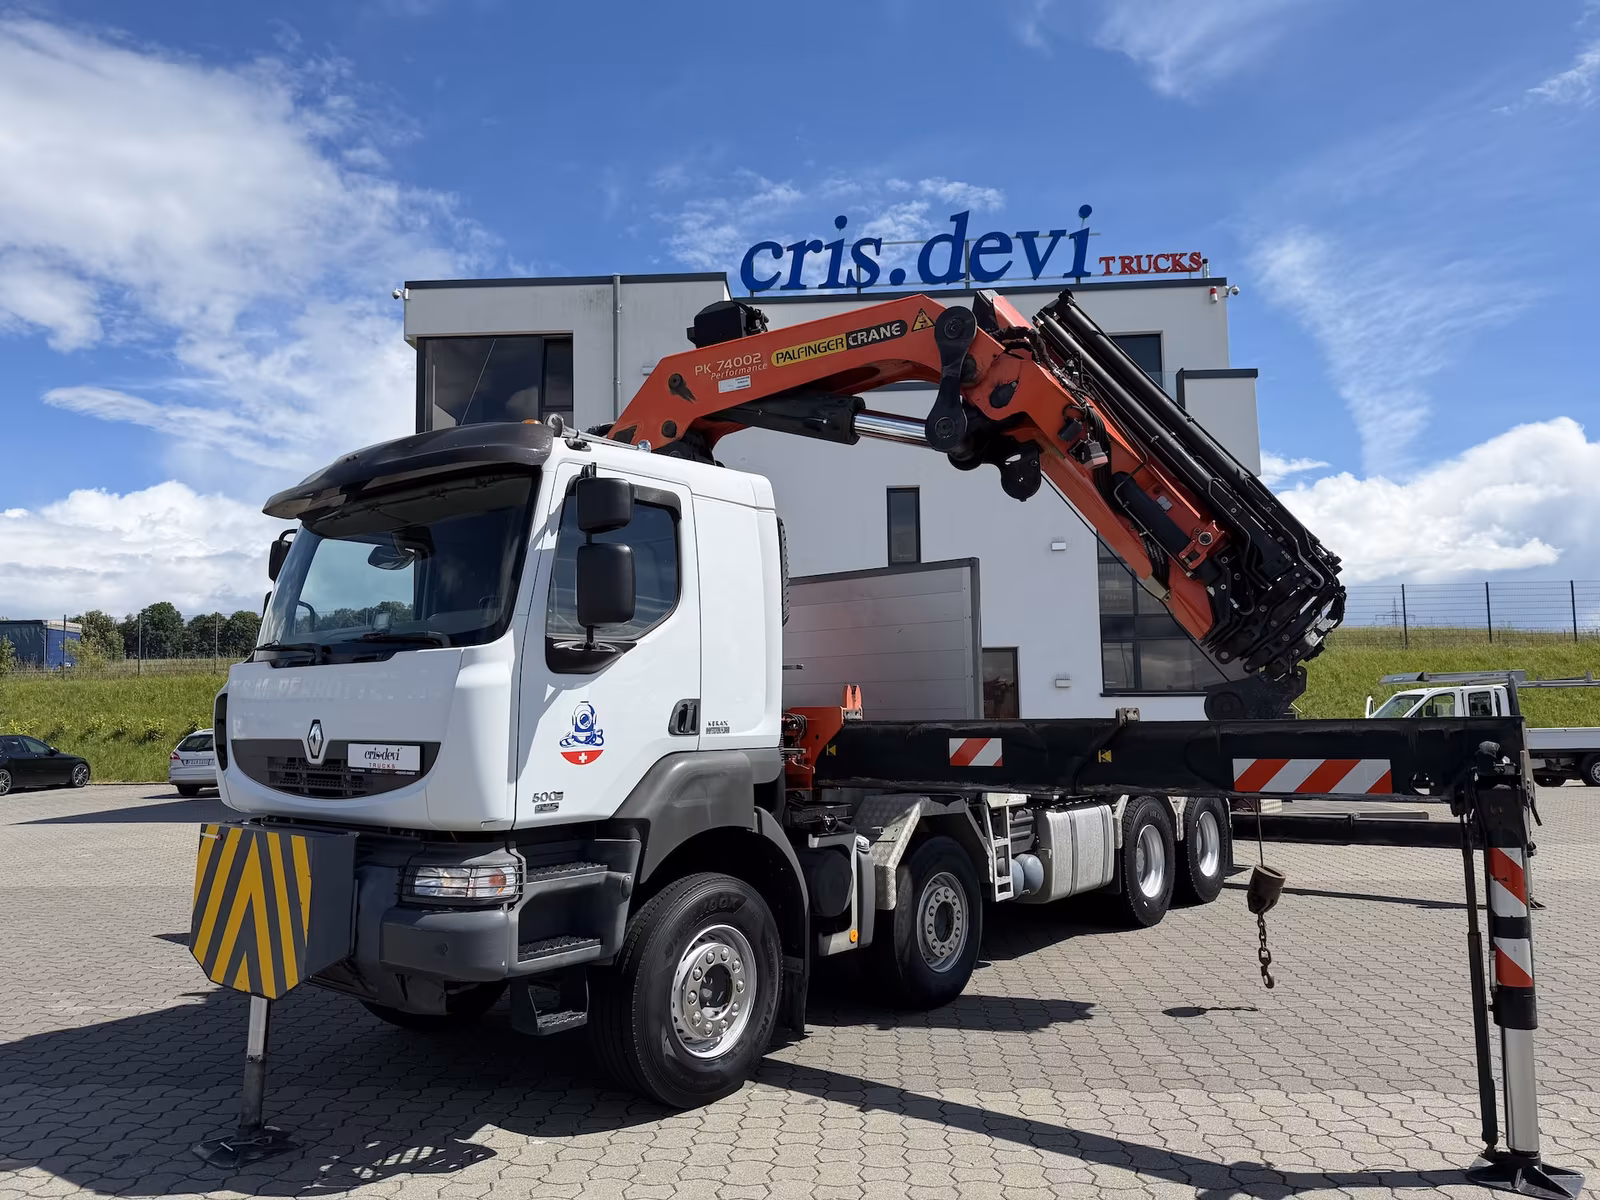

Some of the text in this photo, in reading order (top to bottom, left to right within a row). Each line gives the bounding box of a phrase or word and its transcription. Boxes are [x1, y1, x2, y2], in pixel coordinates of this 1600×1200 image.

[739, 204, 1092, 292] cris.devi
[1099, 251, 1204, 276] TRUCKS
[775, 322, 901, 364] PALFINGER CRANE
[694, 352, 762, 376] PK 74002
[710, 362, 768, 380] Performance
